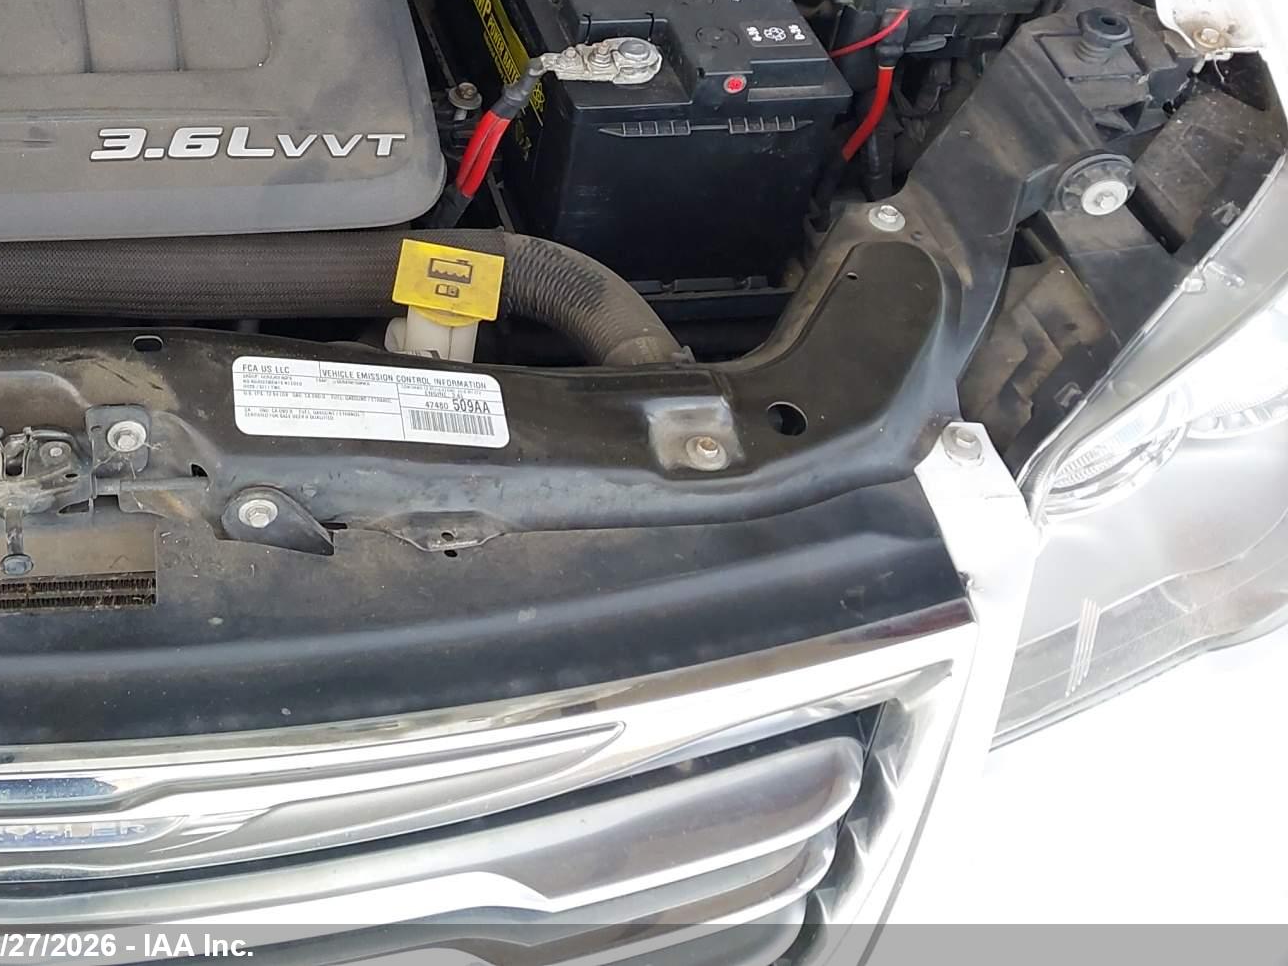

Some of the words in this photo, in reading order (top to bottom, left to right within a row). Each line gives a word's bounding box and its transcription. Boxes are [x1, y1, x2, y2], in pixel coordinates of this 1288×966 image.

[487, 14, 505, 56] POWER
[242, 363, 258, 373] FCA
[261, 365, 273, 373] US
[275, 366, 290, 374] LLC
[322, 369, 355, 380] VEHICLE
[357, 371, 394, 382] EMISSION
[396, 375, 430, 385] CONTROL
[433, 378, 487, 390] INFORMATION
[452, 398, 491, 414] 509AA
